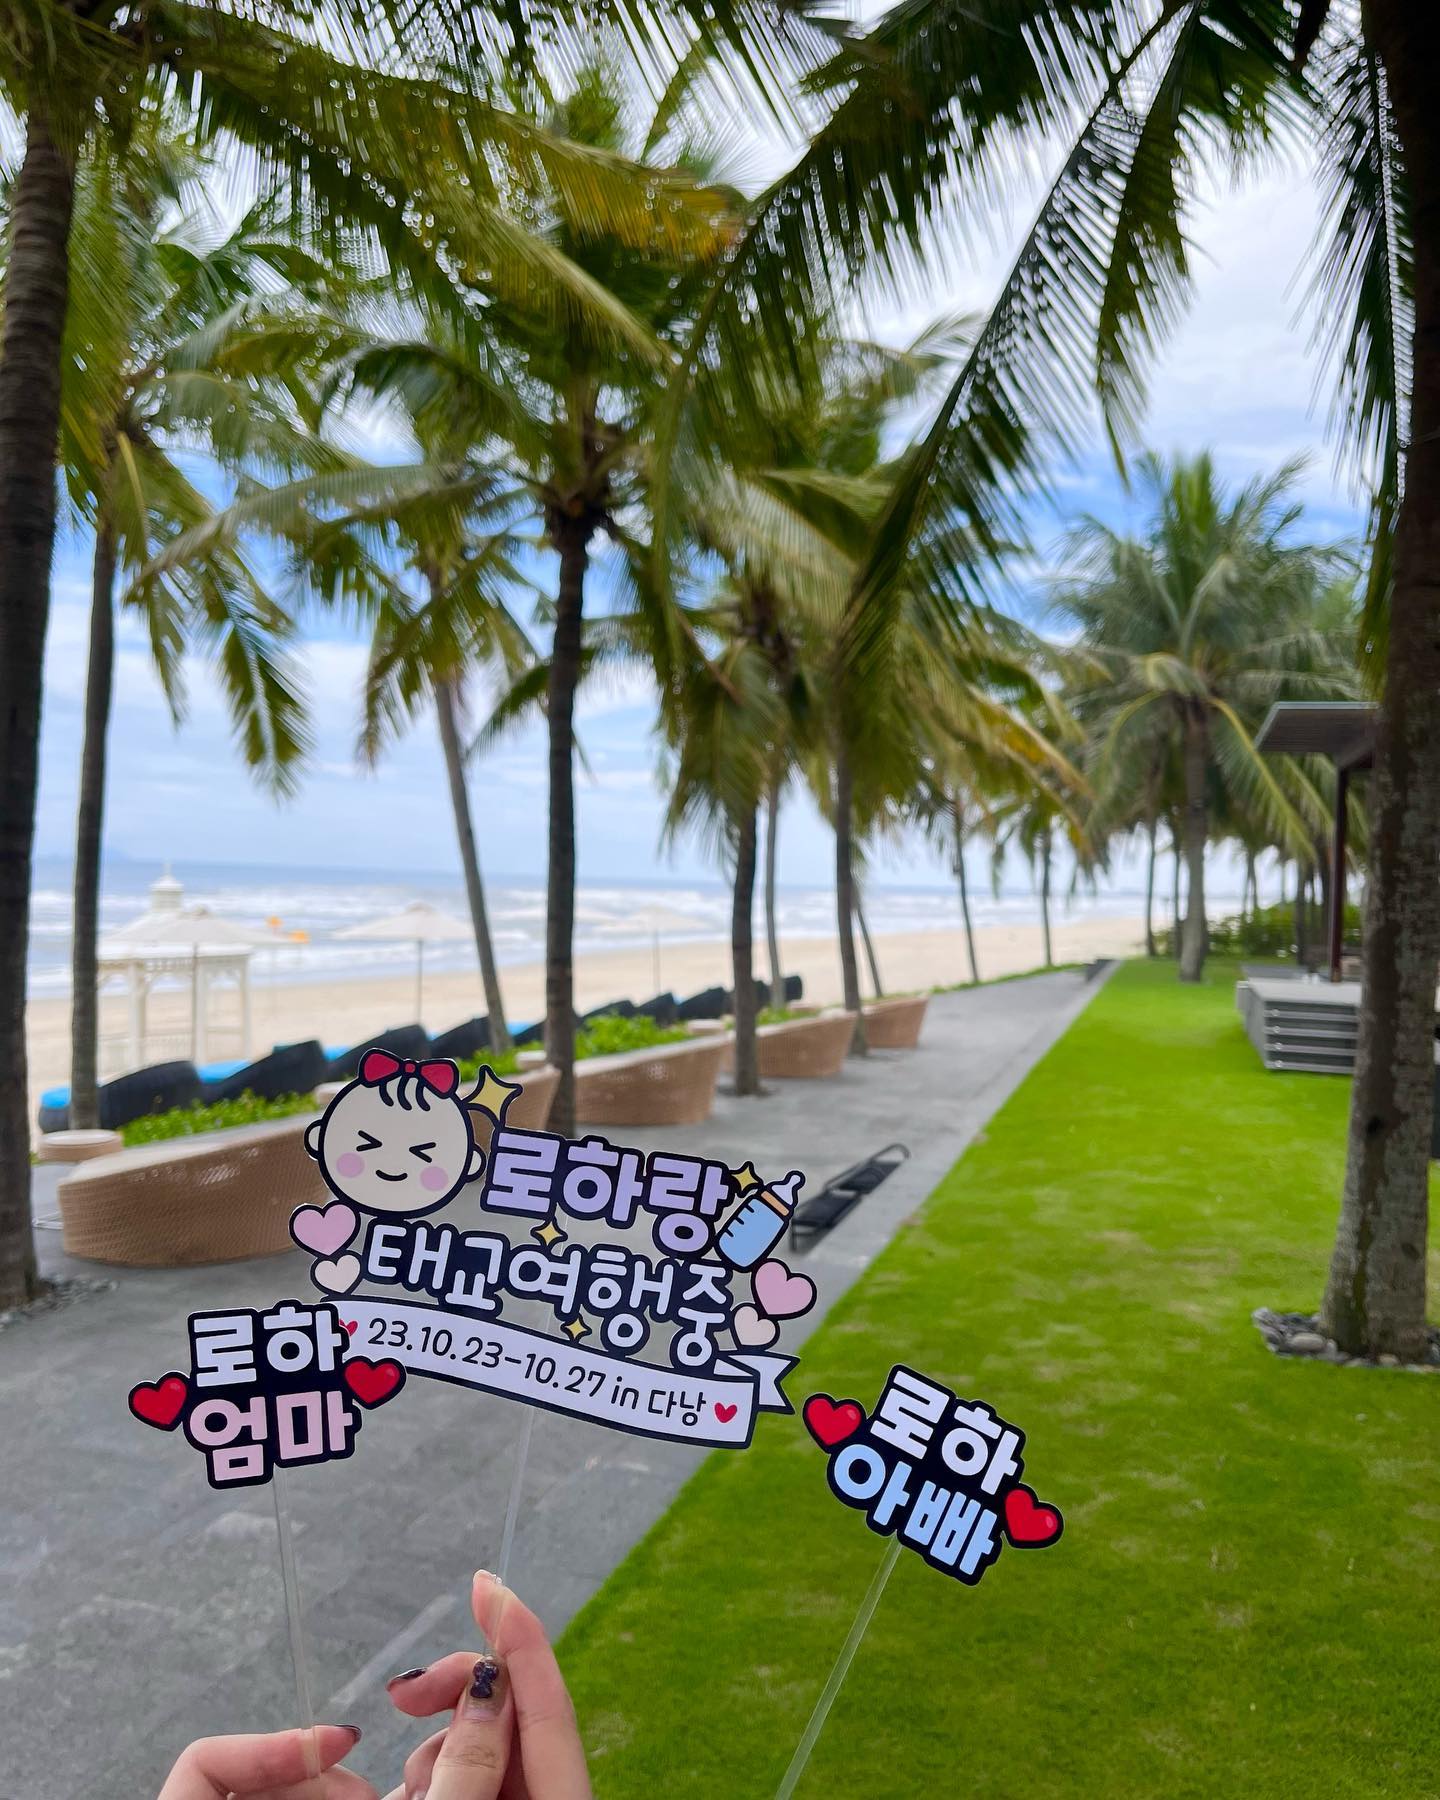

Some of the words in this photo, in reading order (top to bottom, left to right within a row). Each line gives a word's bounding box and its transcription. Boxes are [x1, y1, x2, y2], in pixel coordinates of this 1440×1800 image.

[486, 1132, 730, 1252] 로하랑
[193, 1306, 342, 1387] 로하
[366, 1223, 728, 1367] 태교여행중
[367, 1317, 607, 1397] 23.10.23-10.27
[612, 1377, 638, 1410] in
[647, 1388, 707, 1427] 다낭
[189, 1391, 353, 1481] 엄마
[870, 1370, 1020, 1495] 로하
[834, 1444, 998, 1575] 아빠
